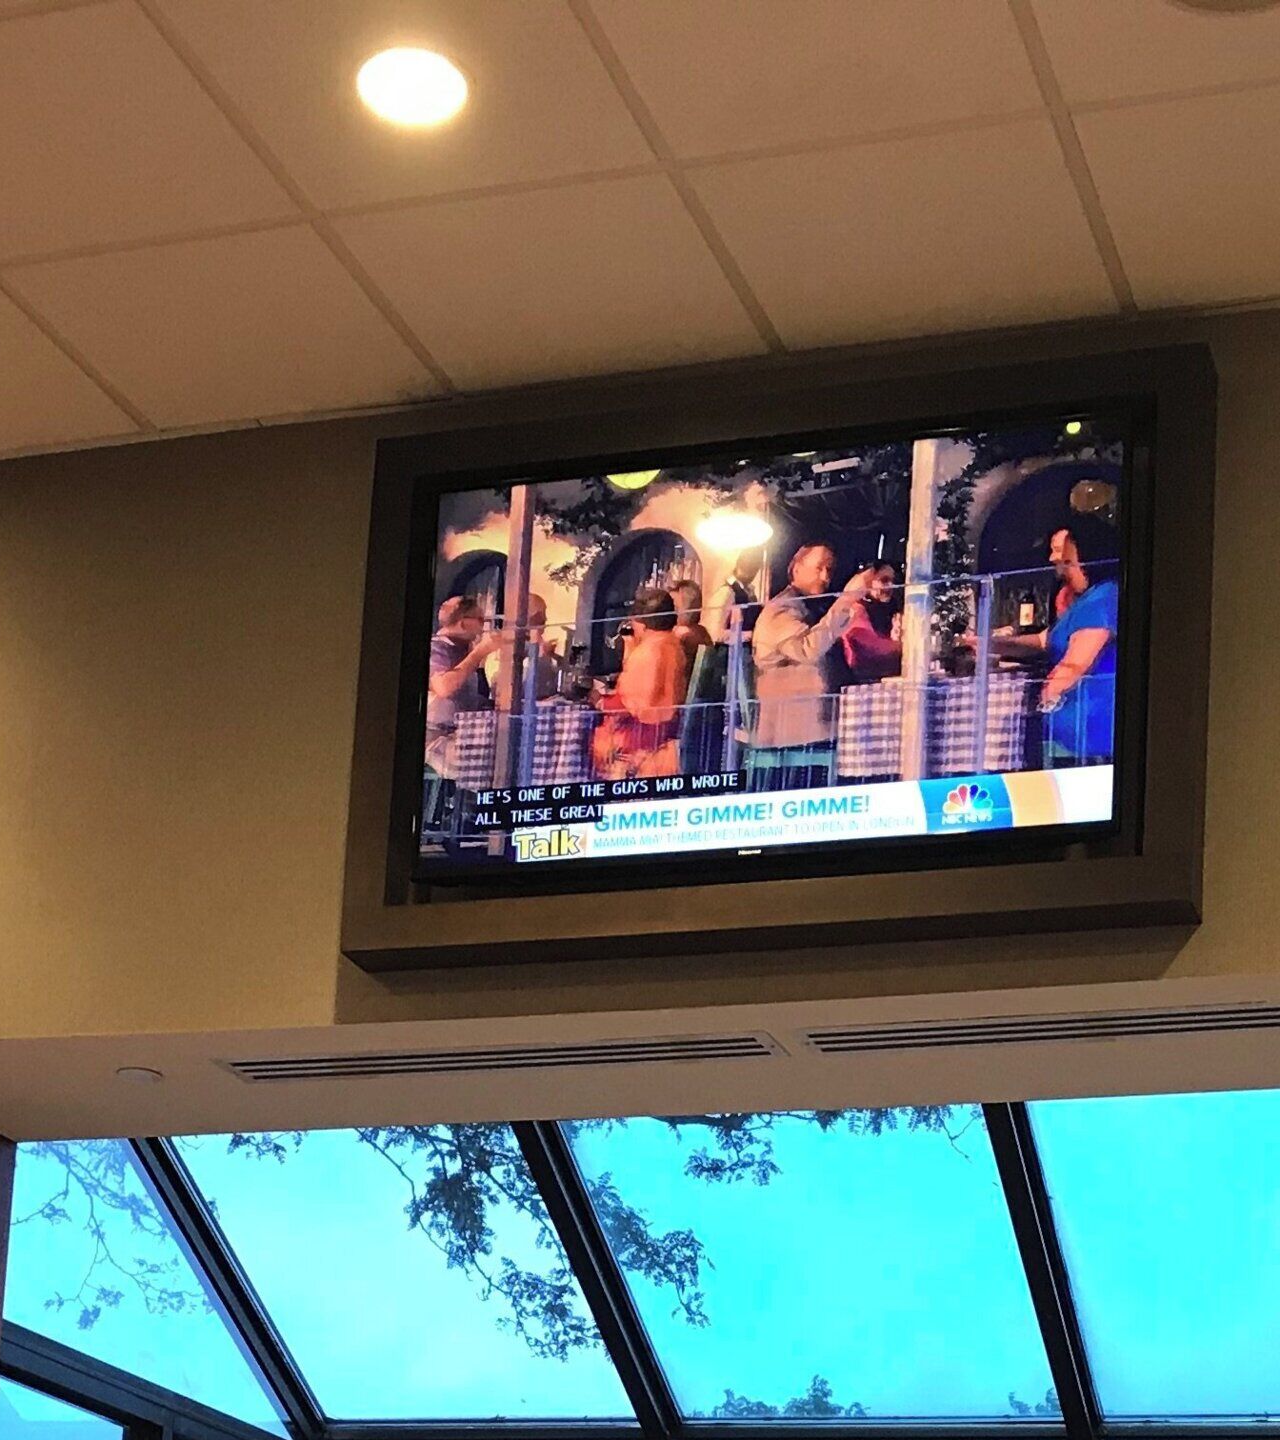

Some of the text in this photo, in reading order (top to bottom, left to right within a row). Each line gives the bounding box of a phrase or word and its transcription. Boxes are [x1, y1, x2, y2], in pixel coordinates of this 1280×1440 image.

[477, 773, 738, 805] HE'S ONE OF THE GUYS WHO WROTE
[475, 803, 603, 826] ALL THESE GREAT
[594, 795, 870, 832] GIMME! GIMME! GIMME!
[514, 829, 581, 860] Talk
